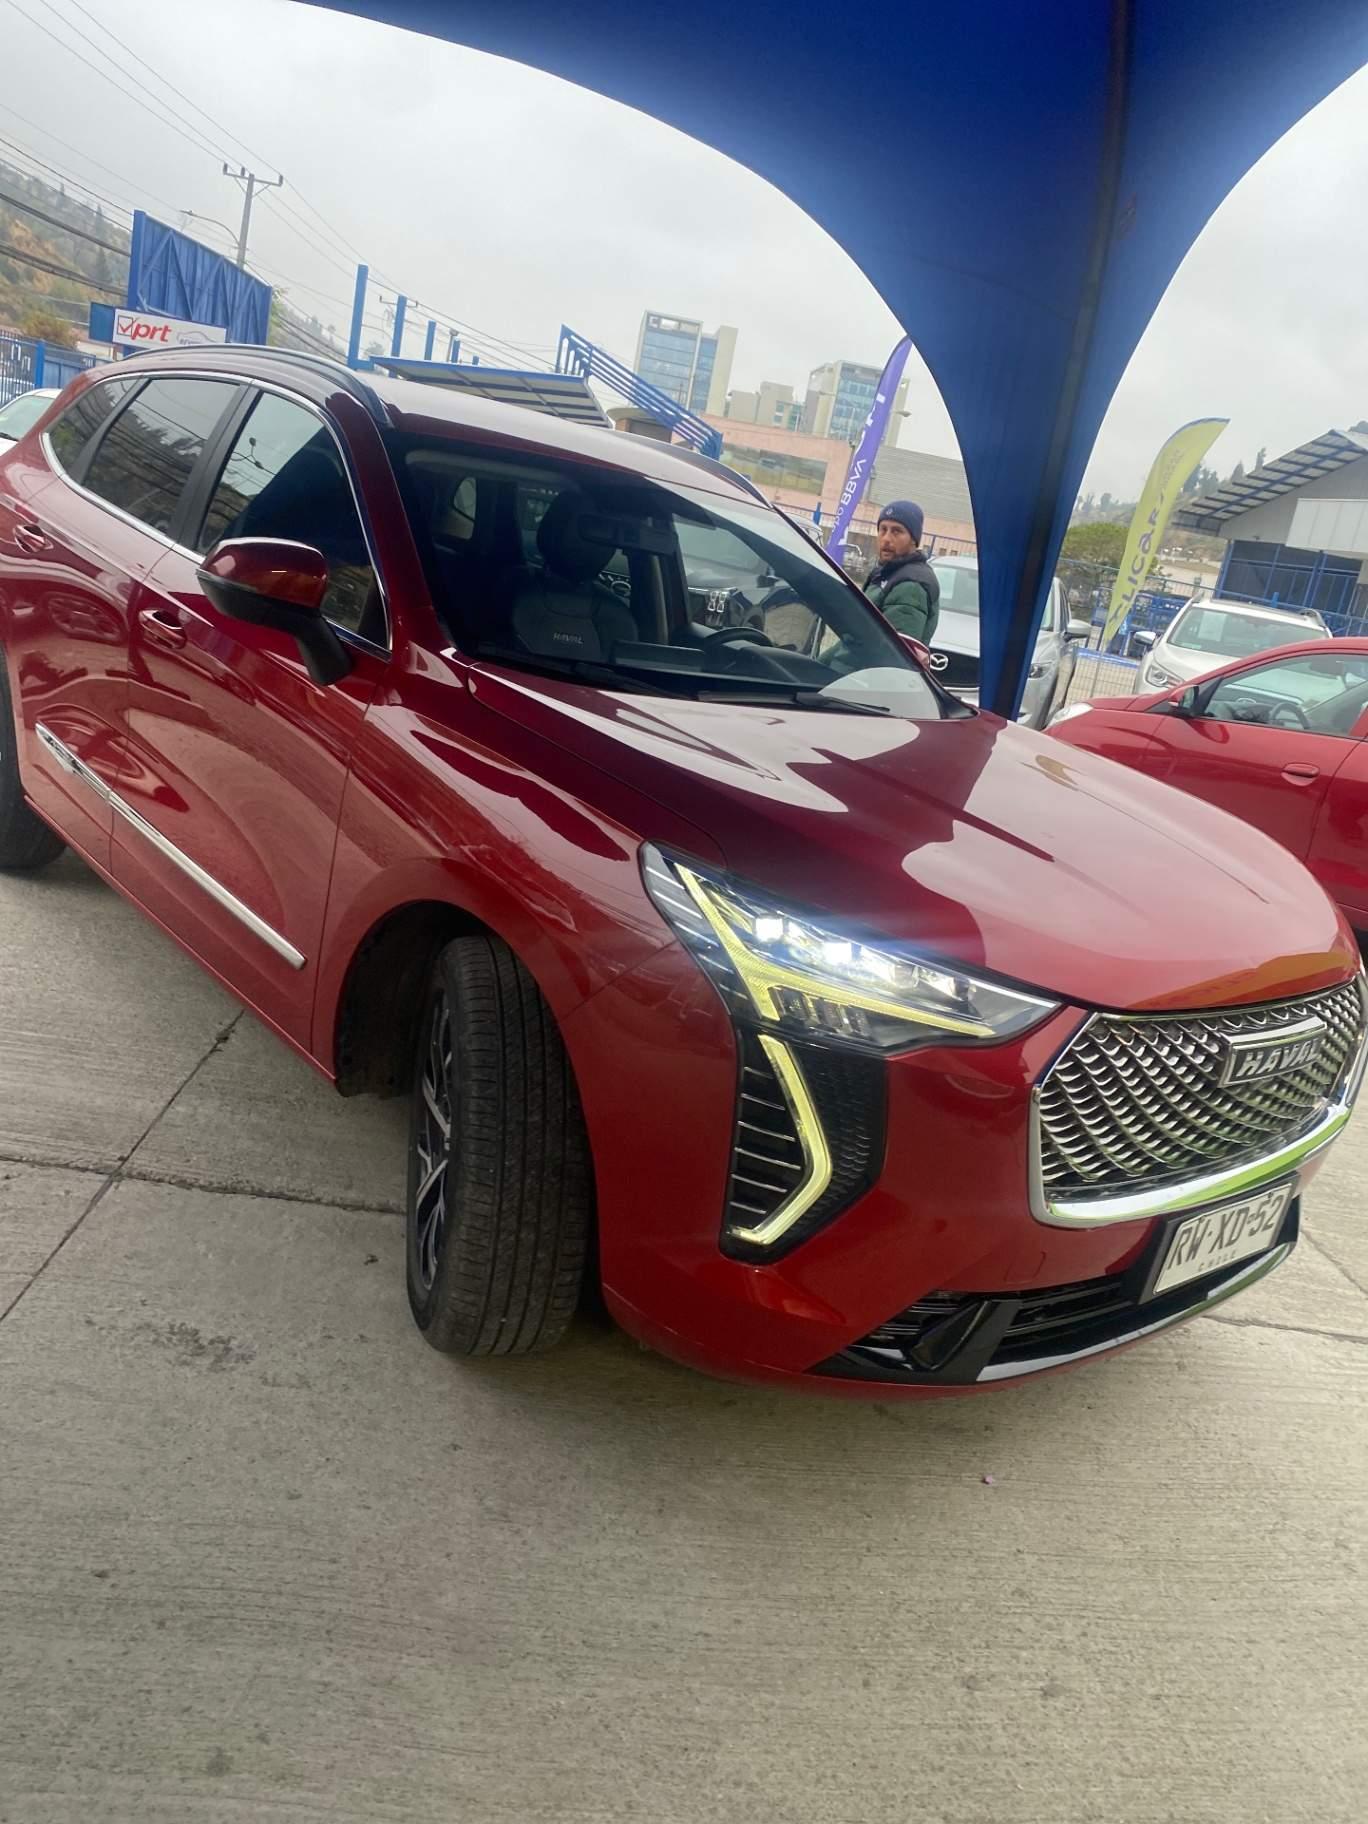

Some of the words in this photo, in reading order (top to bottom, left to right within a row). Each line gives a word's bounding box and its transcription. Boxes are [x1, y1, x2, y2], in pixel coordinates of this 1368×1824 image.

[131, 323, 171, 342] prt
[841, 458, 867, 506] BBVA
[1236, 1037, 1319, 1077] HAVAL
